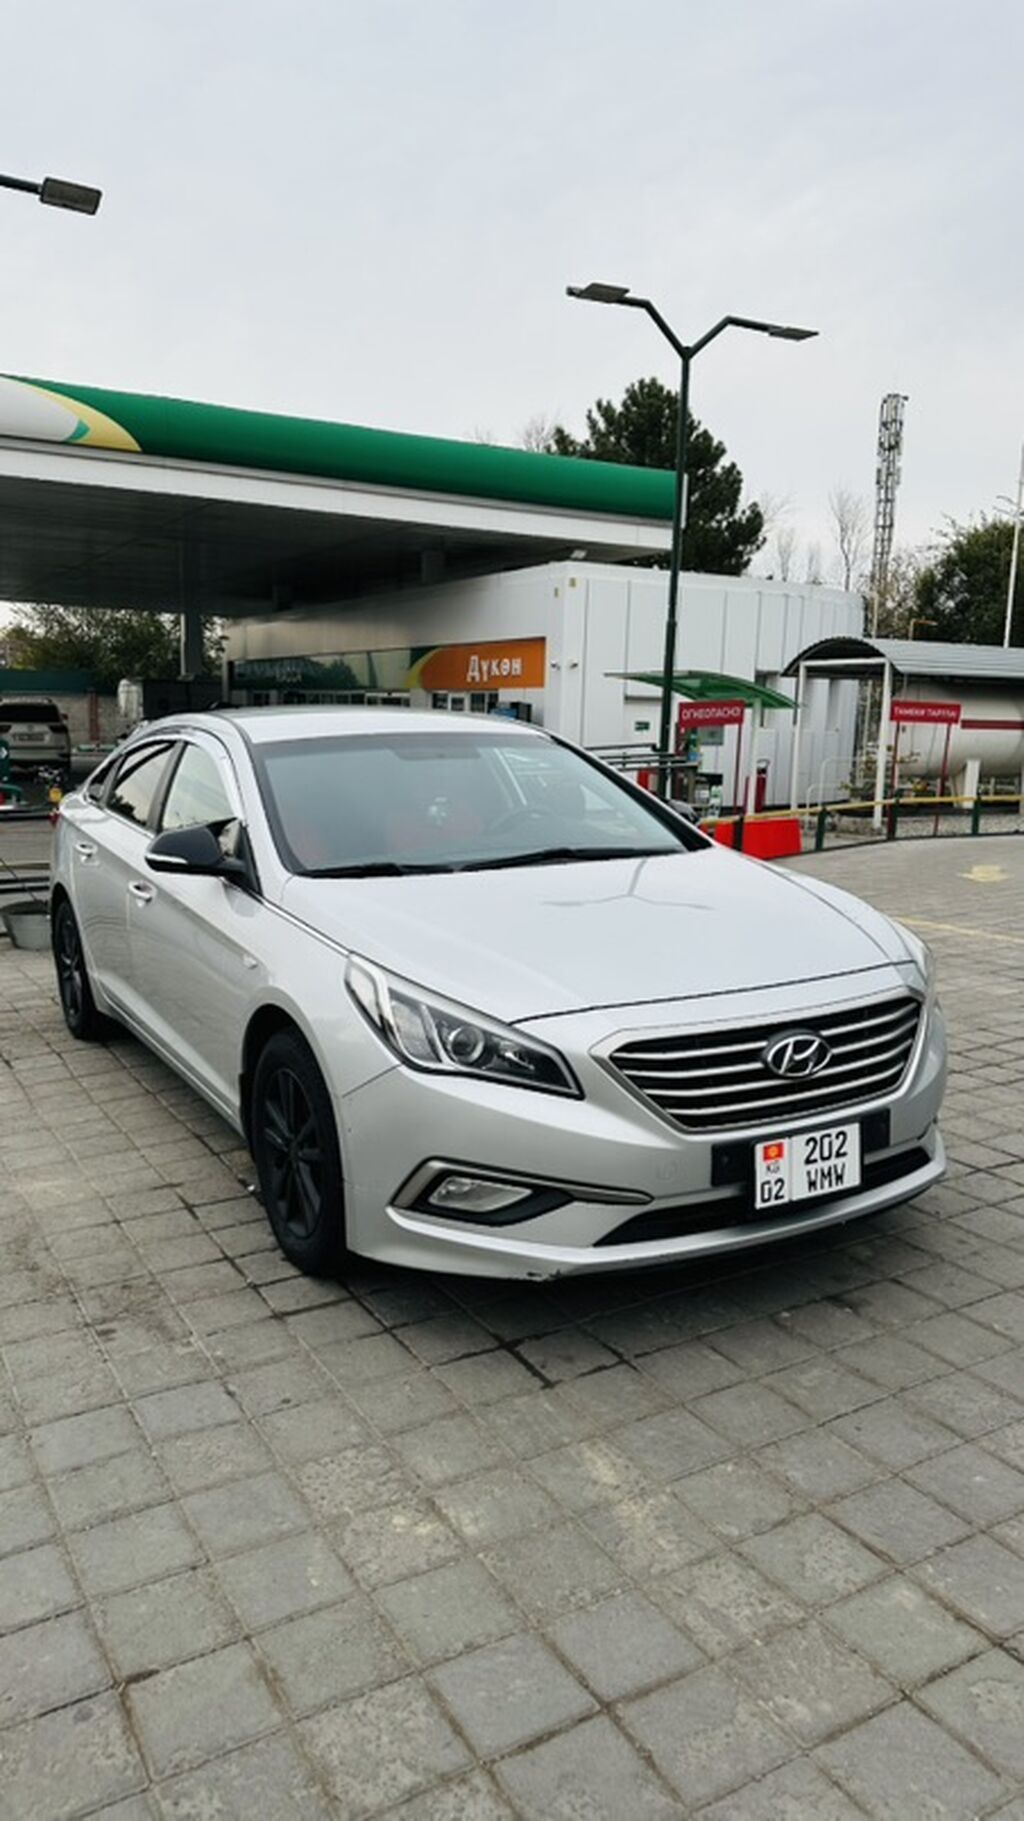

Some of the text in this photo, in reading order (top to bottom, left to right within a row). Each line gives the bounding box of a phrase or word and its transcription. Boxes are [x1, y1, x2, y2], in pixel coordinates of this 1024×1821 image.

[466, 655, 522, 682] Дүкөн
[804, 1130, 848, 1165] 202
[760, 1178, 785, 1203] 02
[806, 1163, 846, 1192] WMW
